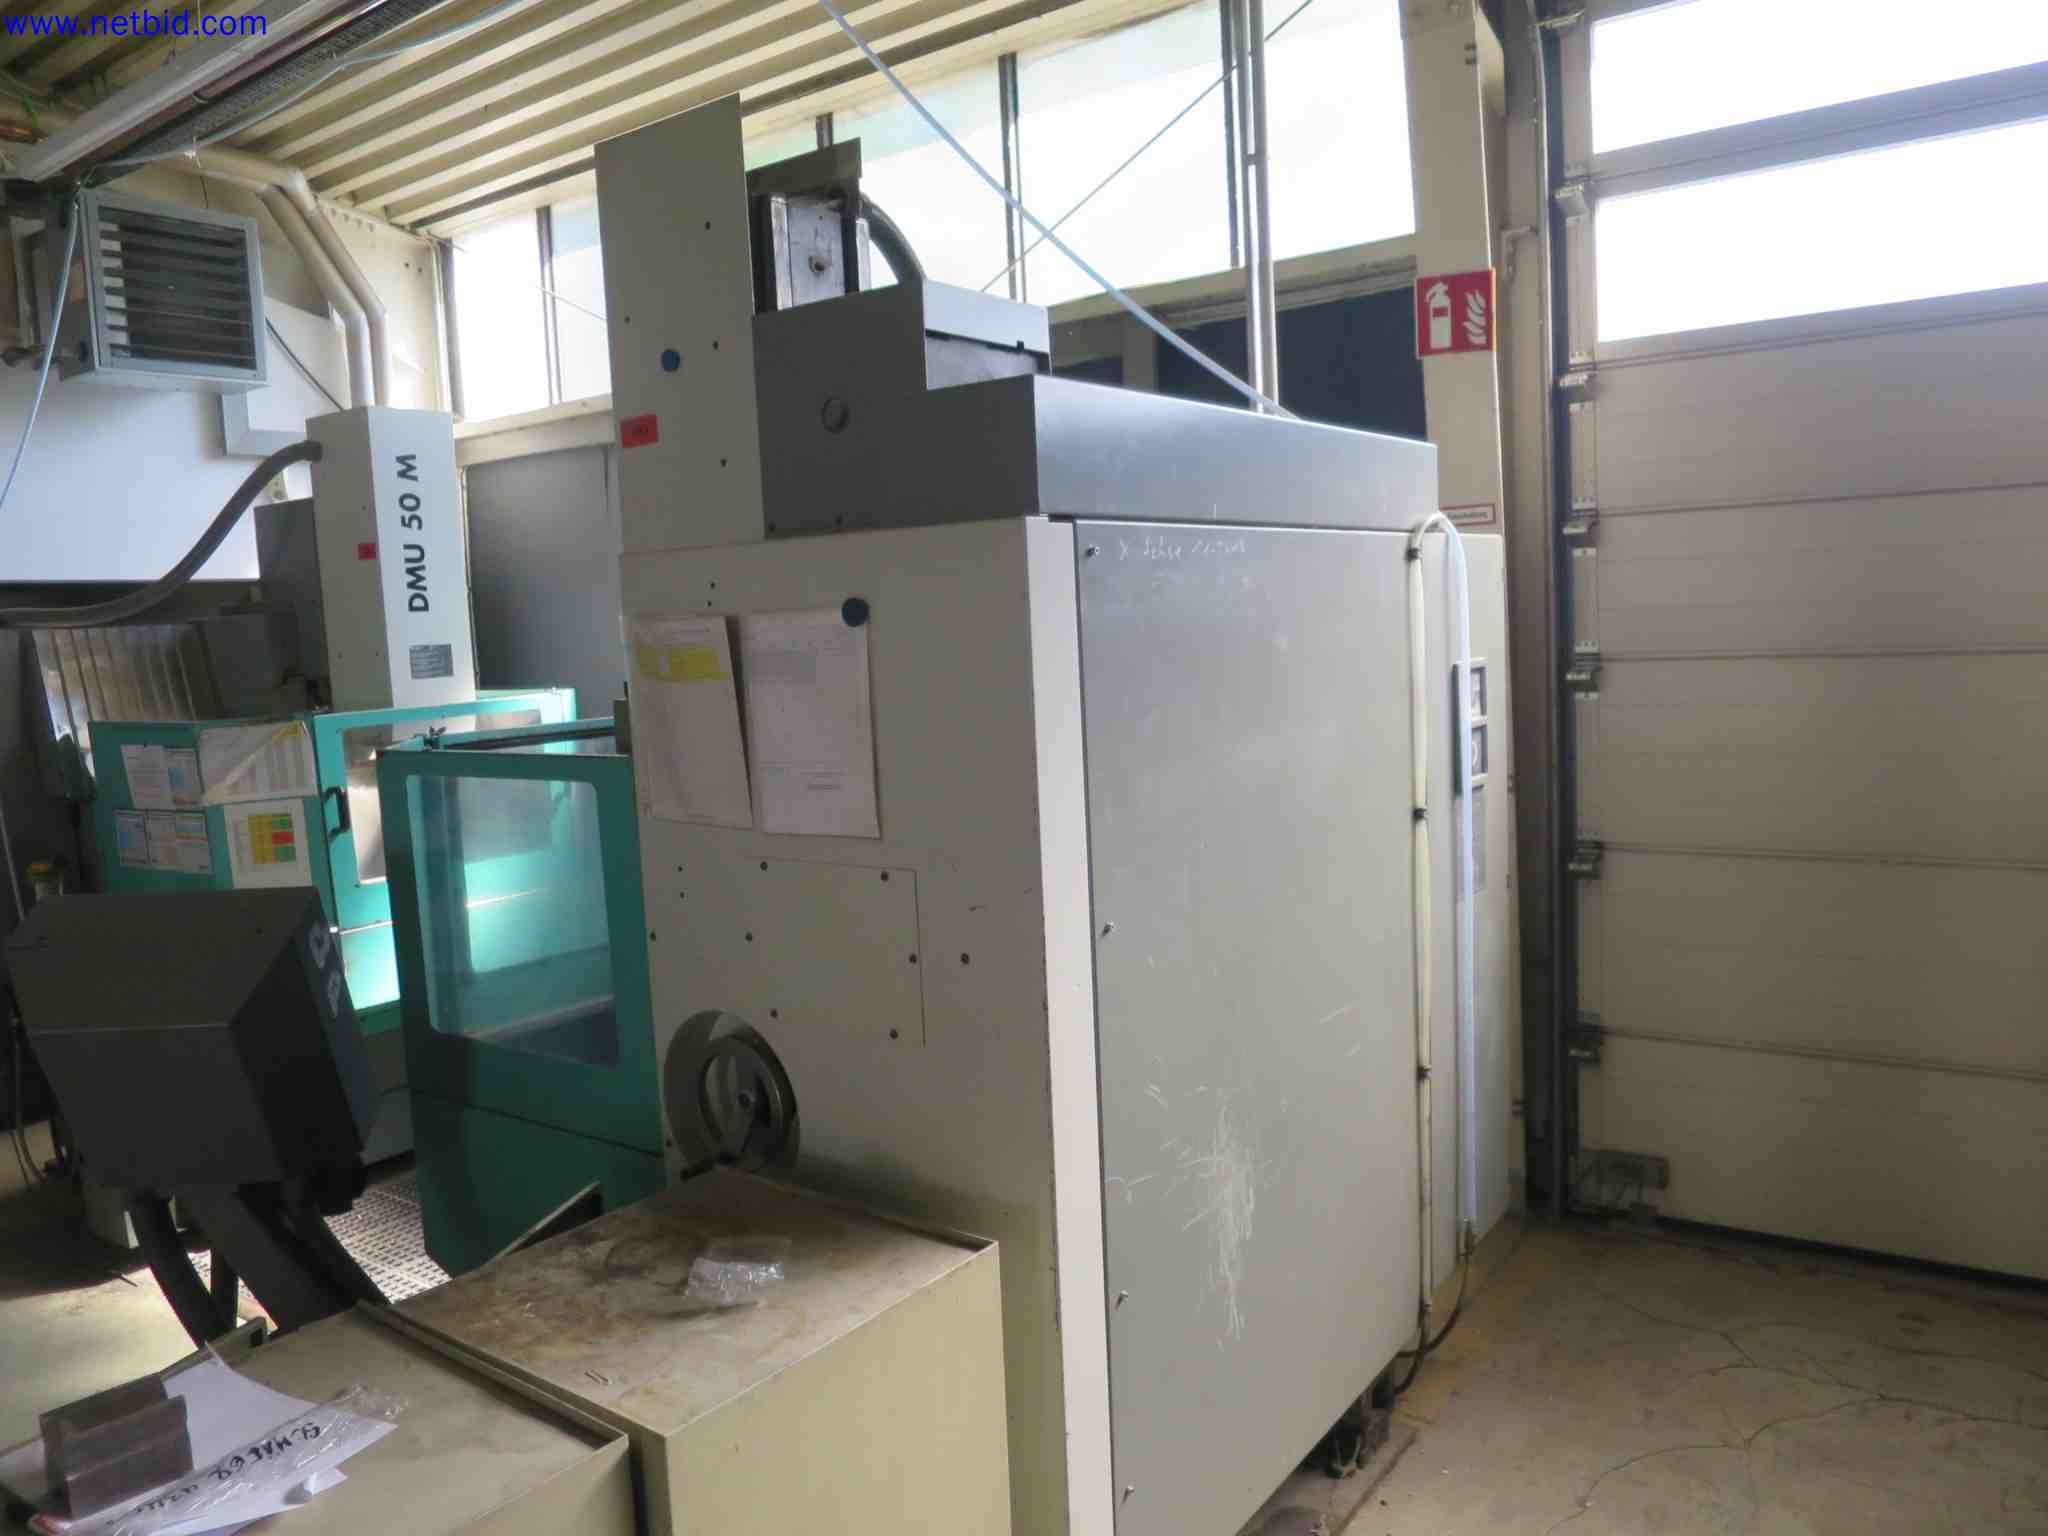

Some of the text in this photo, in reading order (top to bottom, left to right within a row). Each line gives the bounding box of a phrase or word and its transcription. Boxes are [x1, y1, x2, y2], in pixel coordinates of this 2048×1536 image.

[395, 454, 429, 612] DMU 50 M
